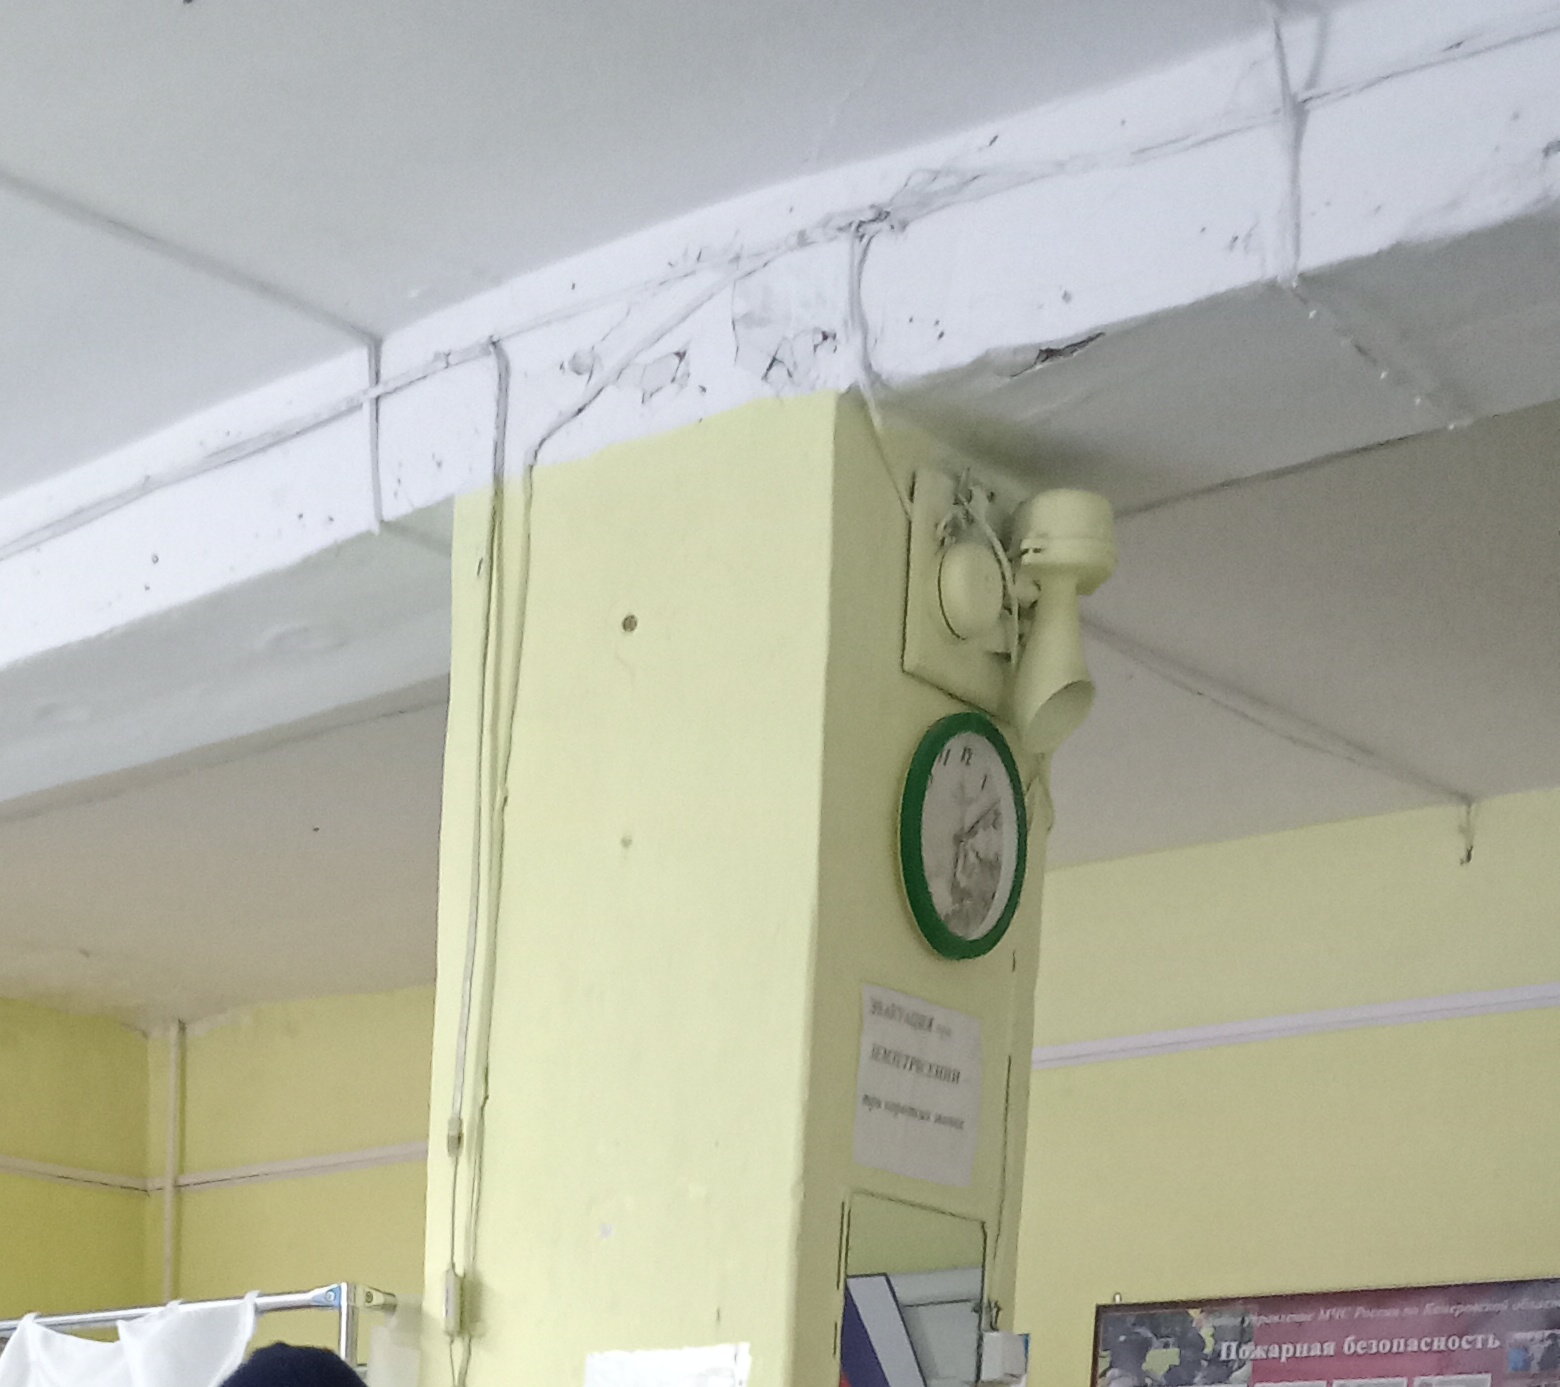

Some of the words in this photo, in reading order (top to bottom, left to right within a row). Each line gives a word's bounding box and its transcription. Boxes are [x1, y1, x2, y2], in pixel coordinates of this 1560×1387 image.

[960, 746, 973, 767] 12
[1218, 1340, 1337, 1363] Пожарная
[1342, 1333, 1501, 1356] безопасность
